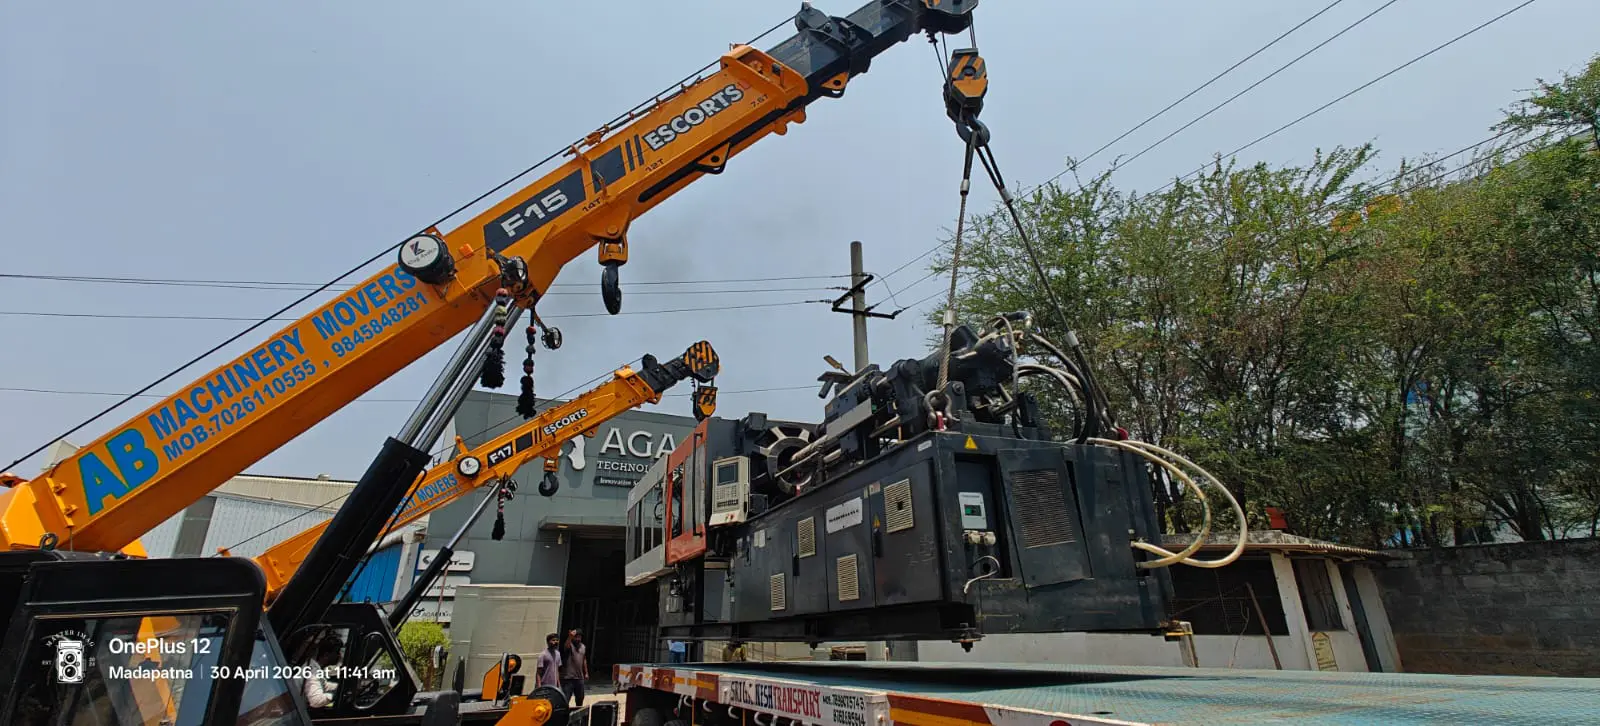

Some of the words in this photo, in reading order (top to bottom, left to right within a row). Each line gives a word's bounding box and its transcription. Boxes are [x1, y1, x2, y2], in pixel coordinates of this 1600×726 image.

[644, 84, 743, 150] ESCORTS
[645, 158, 664, 172] 12T
[501, 188, 568, 238] F15
[582, 197, 603, 213] 14T
[78, 428, 159, 516] AB
[147, 328, 305, 441] MACHINERY
[311, 266, 416, 340] MOVERS
[162, 359, 316, 461] MOB:7026110555
[331, 291, 428, 357] 9845848281
[543, 408, 588, 436] ESCORTS
[489, 446, 512, 464] F17
[416, 473, 458, 502] MOVERS
[773, 686, 821, 719] TRANSPORT
